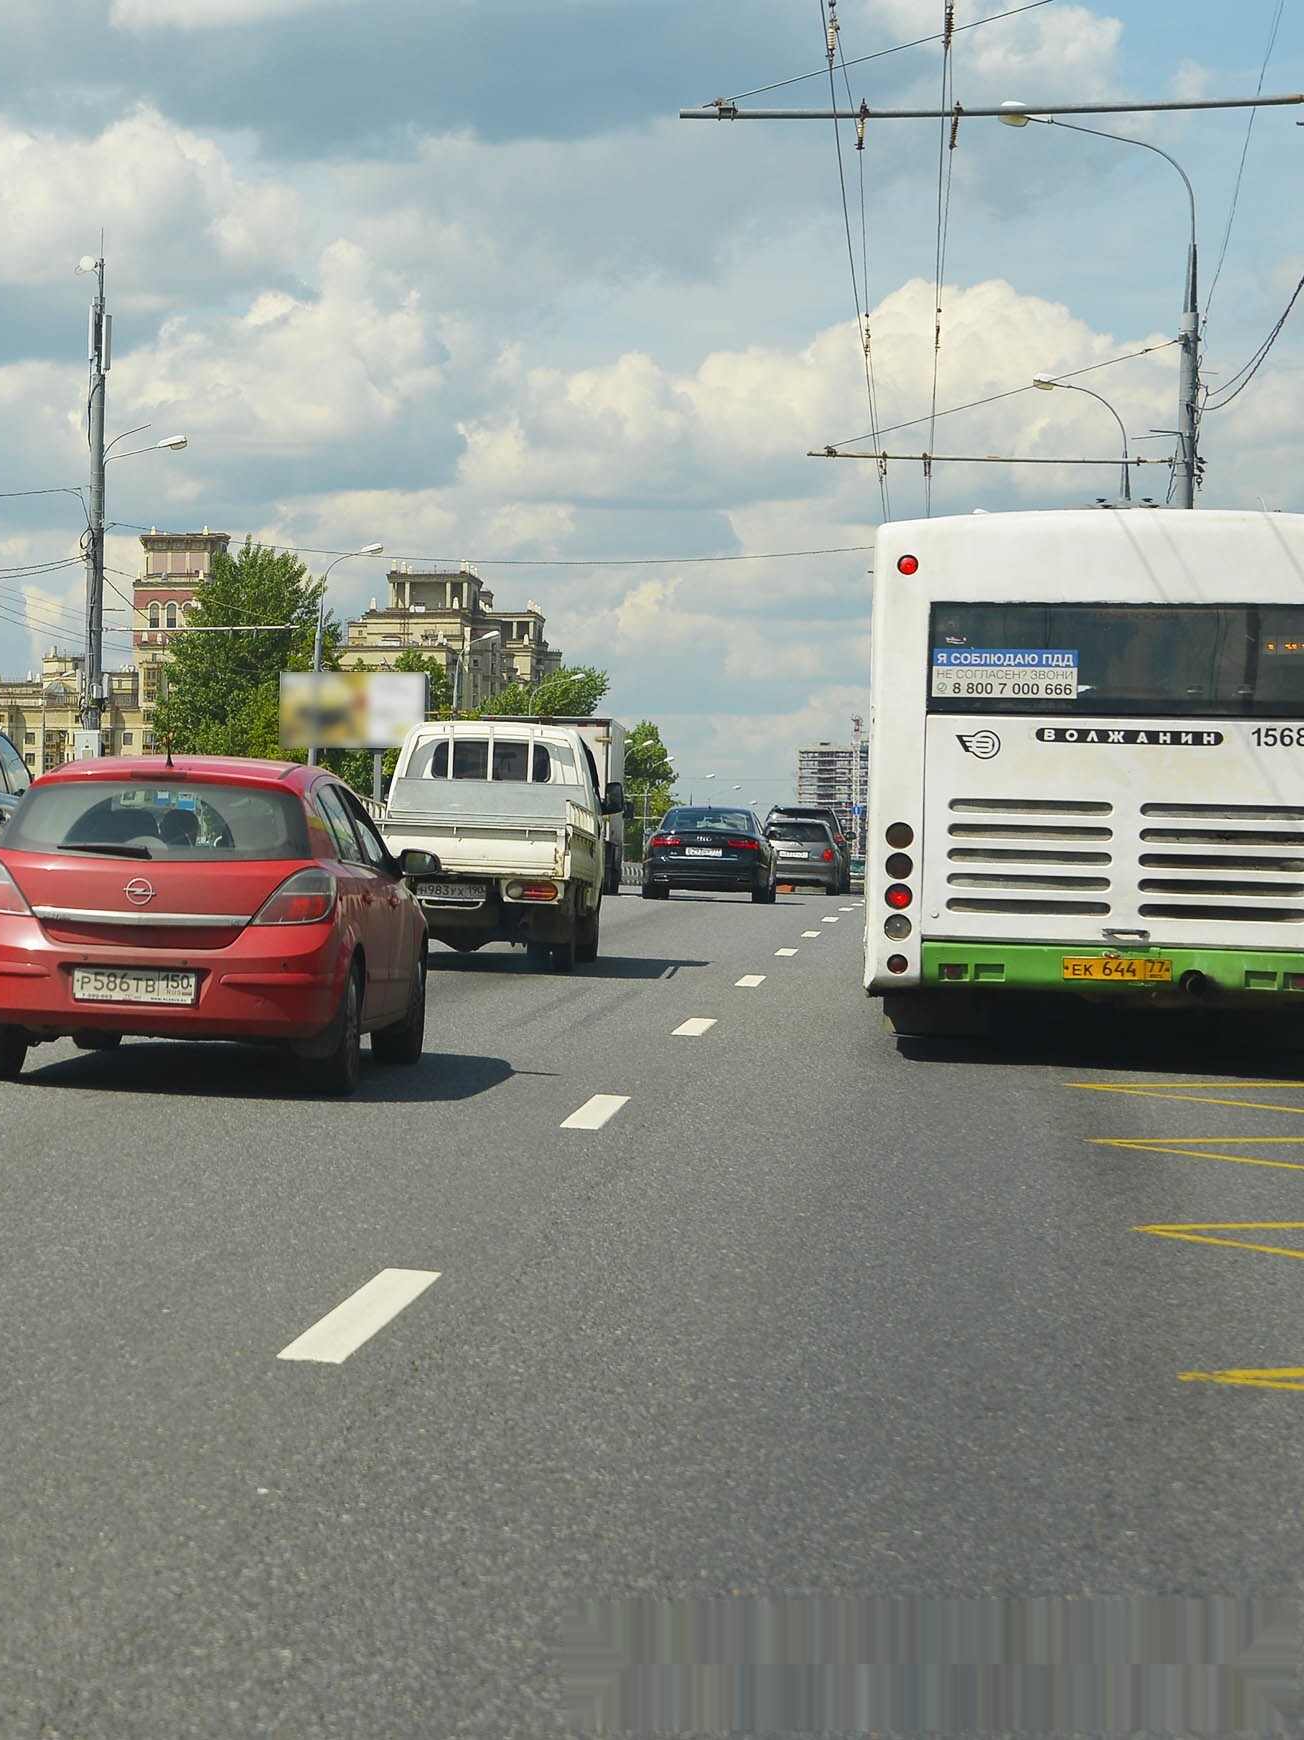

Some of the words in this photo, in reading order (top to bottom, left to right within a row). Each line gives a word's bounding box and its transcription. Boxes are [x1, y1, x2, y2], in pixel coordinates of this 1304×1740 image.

[937, 653, 947, 664] Я
[950, 653, 1039, 666] СОБЛЮДАЮ
[1042, 654, 1074, 667] ПДД
[936, 669, 953, 679] НЕ
[956, 669, 1027, 680] СОГЛАСЕН?
[1030, 669, 1074, 680] ЗВОНИ
[952, 682, 961, 694] 8
[966, 682, 994, 695] 800
[998, 683, 1007, 695] 7
[1012, 683, 1040, 695] 000
[1045, 684, 1073, 696] 666
[1042, 728, 1216, 745] ВОЛЖАНИН
[1102, 961, 1137, 977] 644
[162, 973, 190, 989] 150
